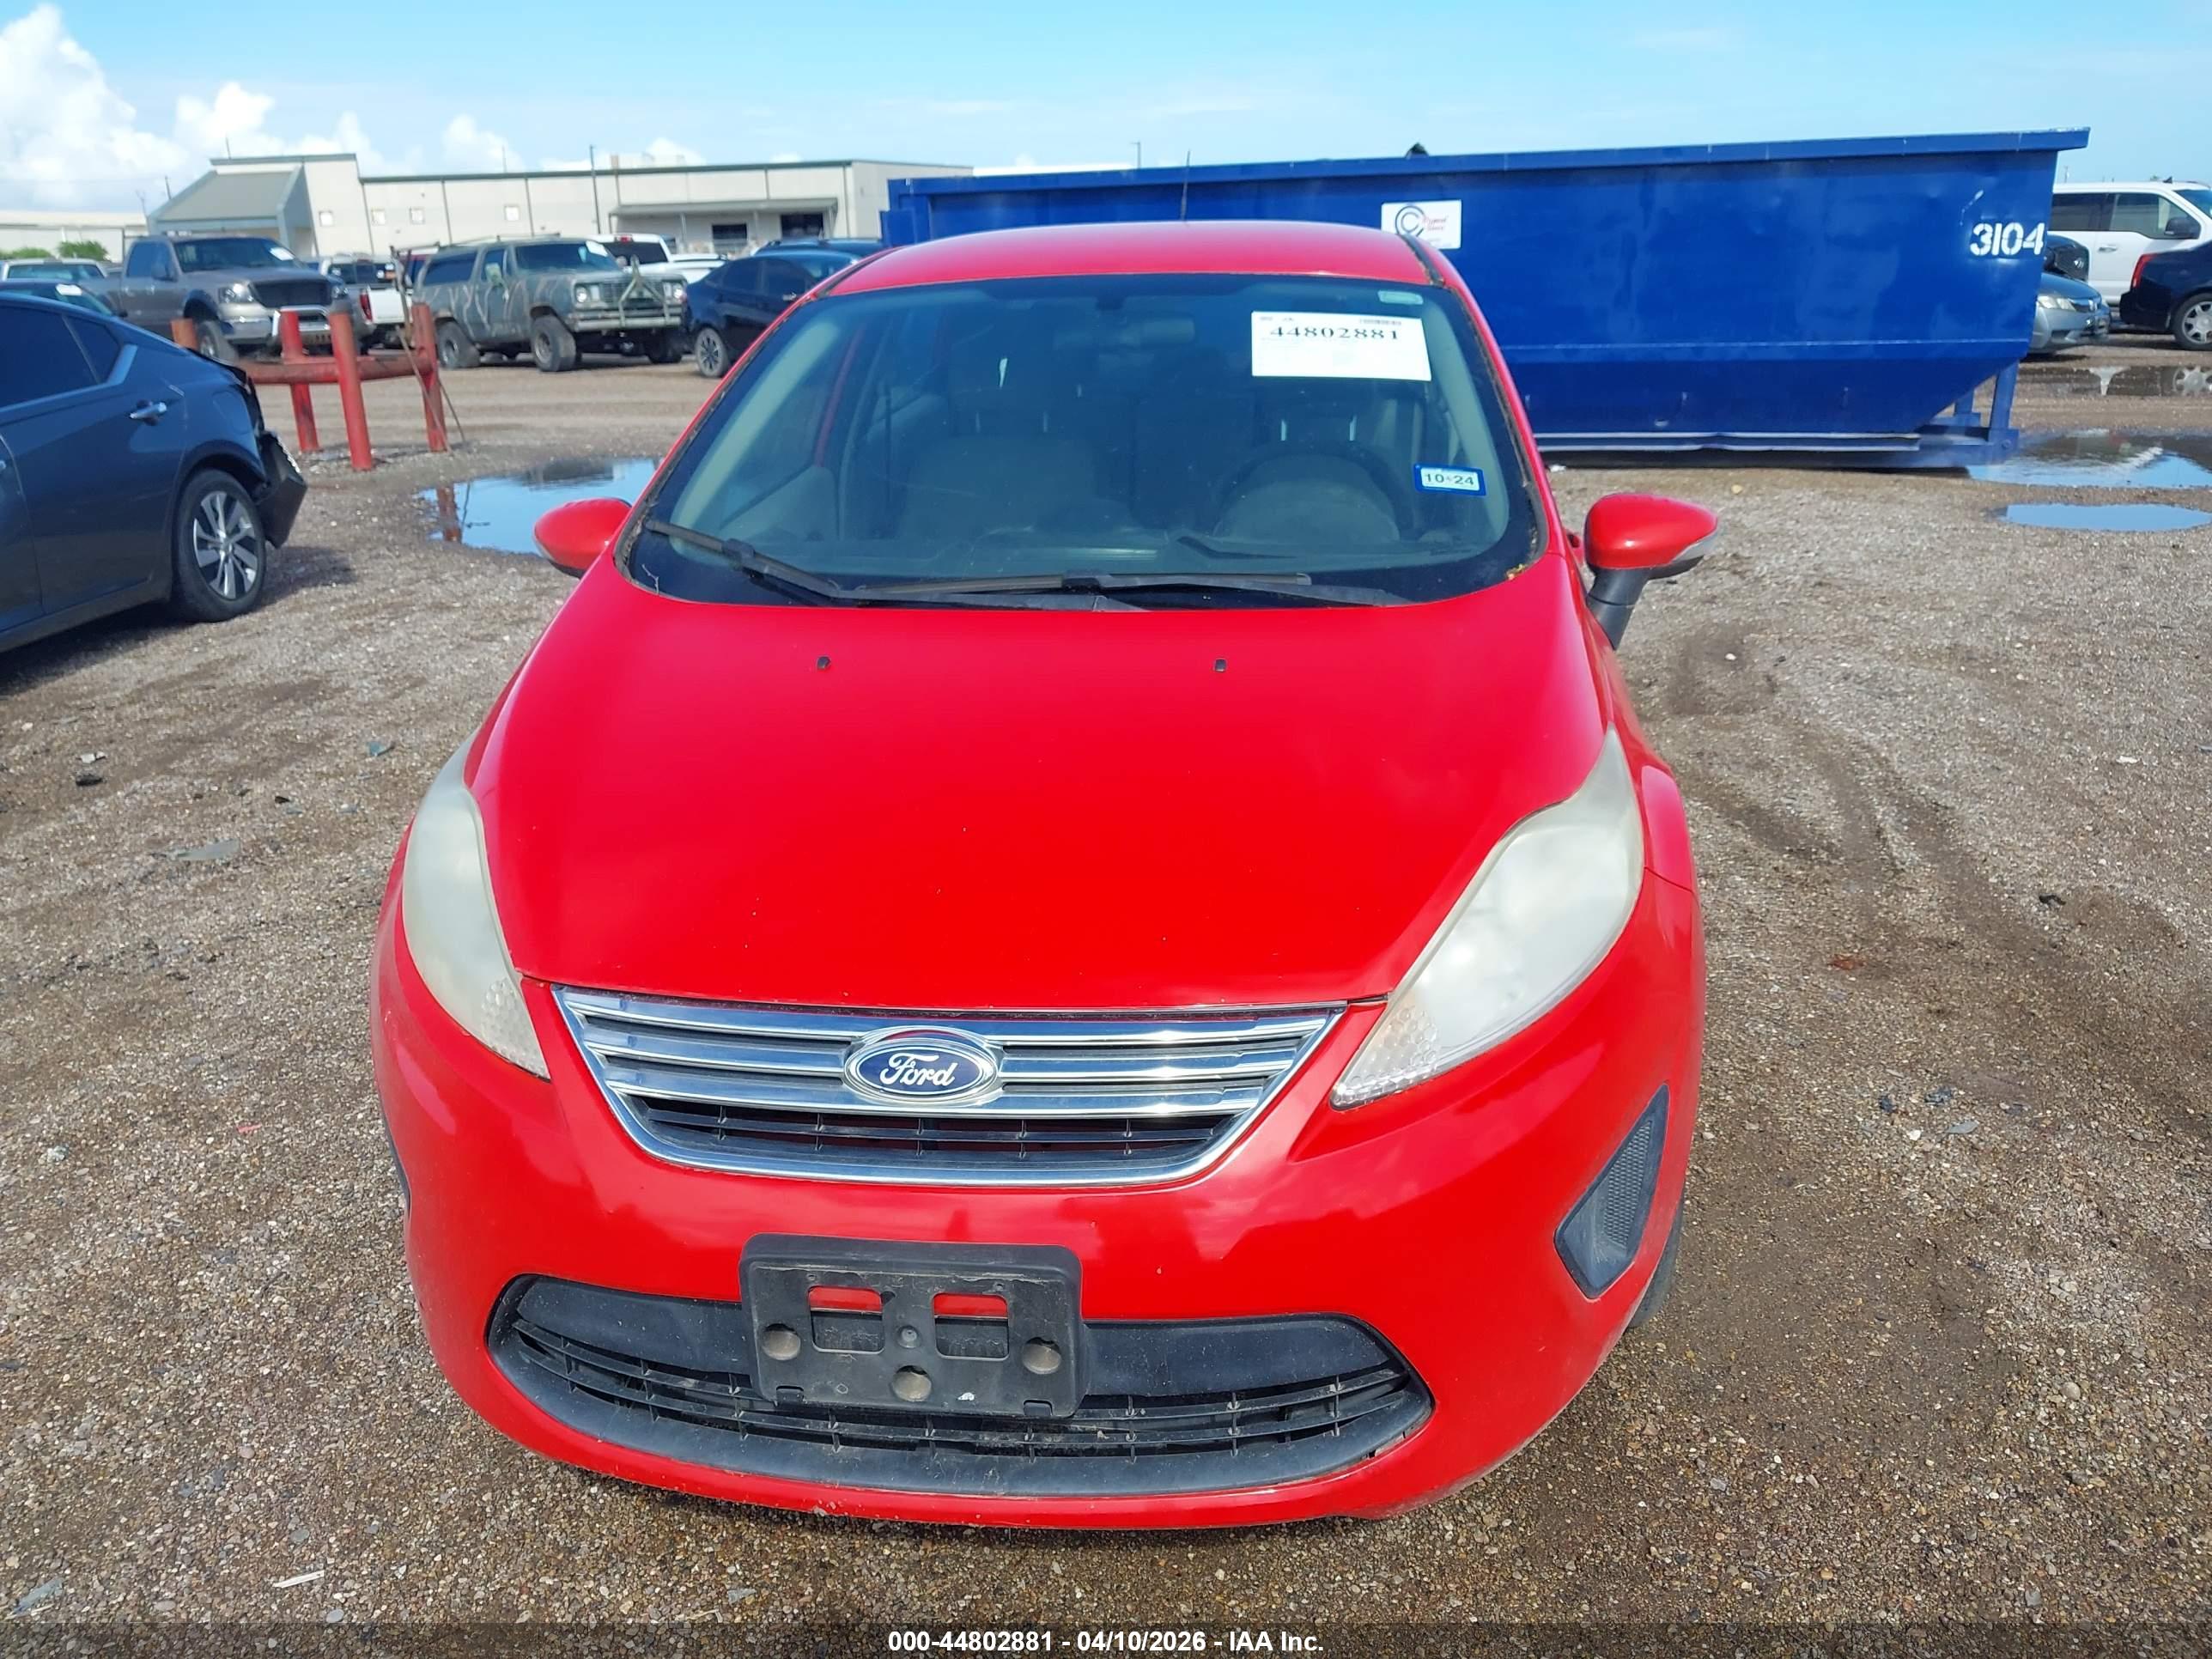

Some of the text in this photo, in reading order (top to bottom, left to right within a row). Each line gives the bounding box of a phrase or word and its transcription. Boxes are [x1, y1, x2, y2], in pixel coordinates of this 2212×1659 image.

[1970, 222, 2045, 256] 3104
[1270, 325, 1399, 340] 44802881
[879, 1052, 958, 1086] Ford
